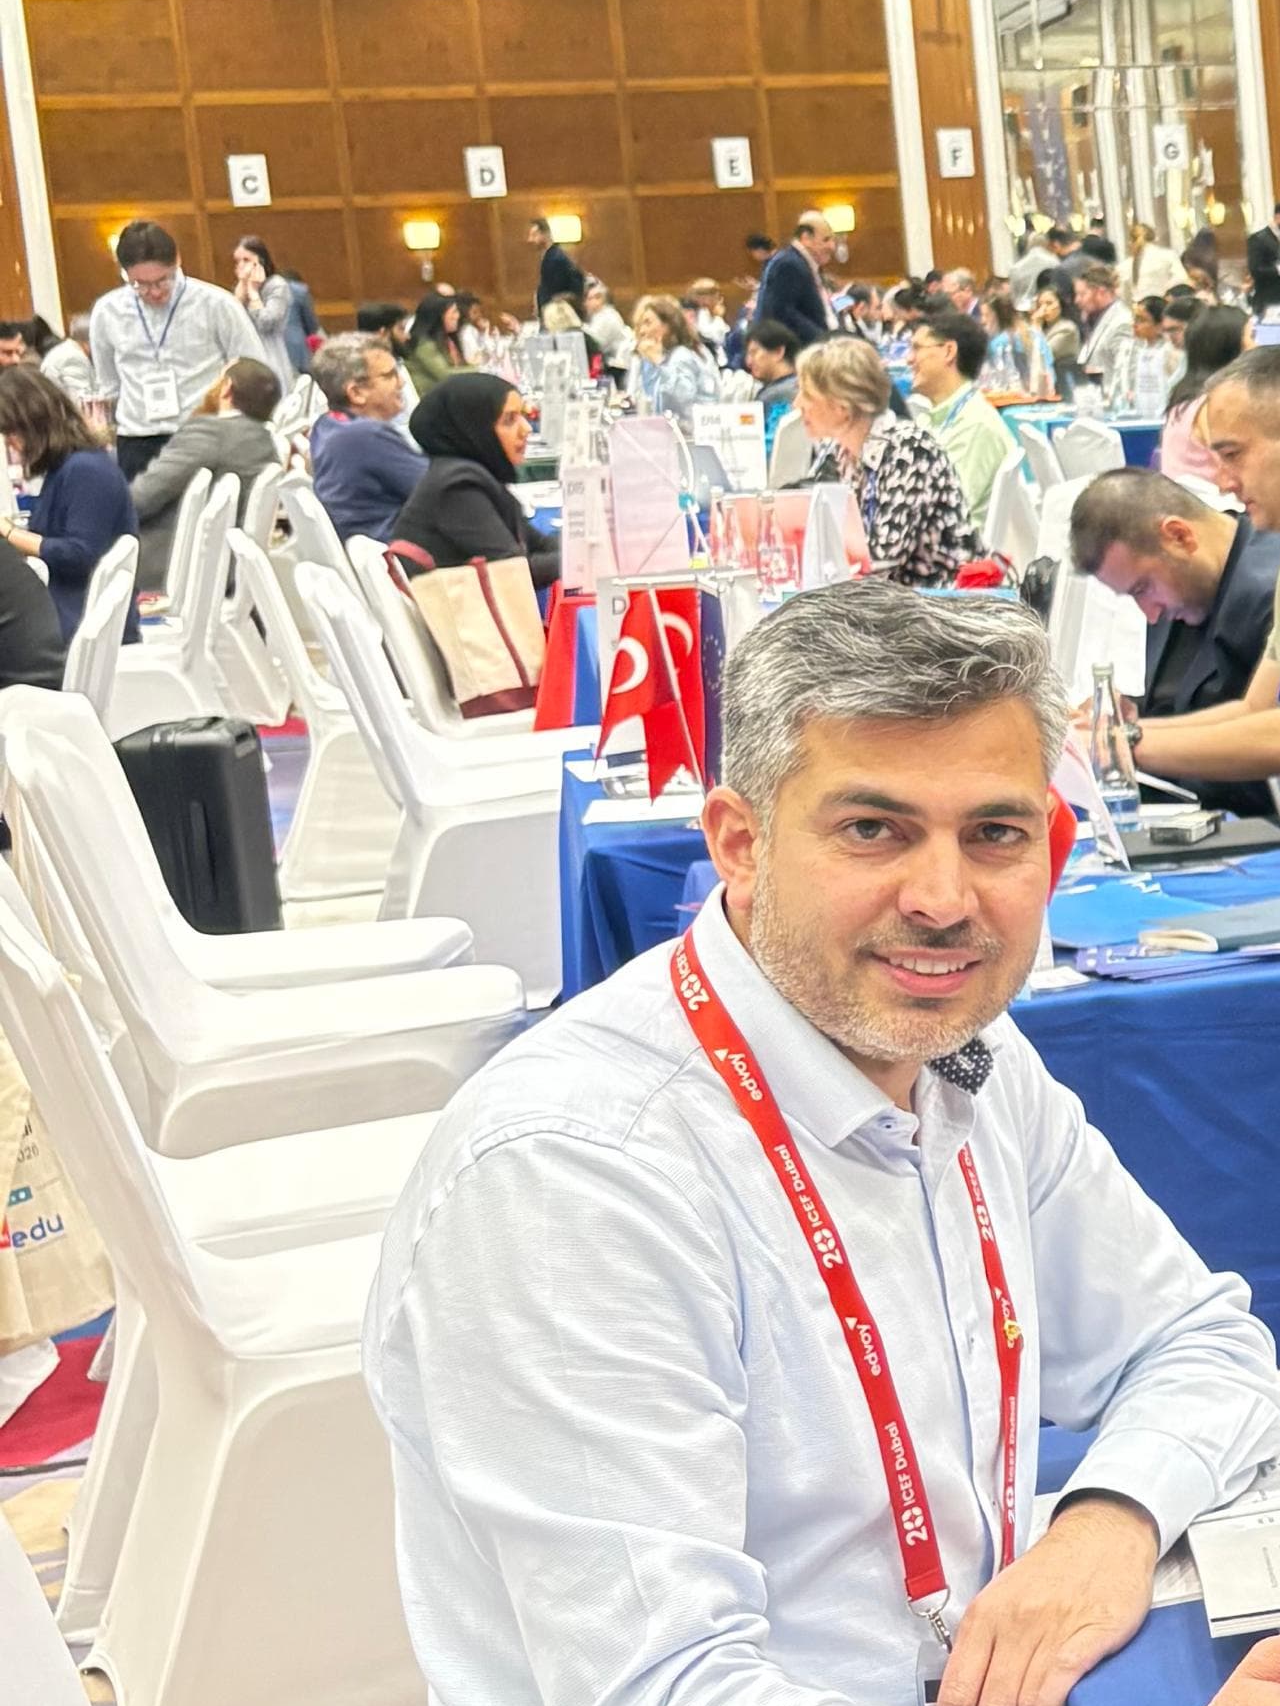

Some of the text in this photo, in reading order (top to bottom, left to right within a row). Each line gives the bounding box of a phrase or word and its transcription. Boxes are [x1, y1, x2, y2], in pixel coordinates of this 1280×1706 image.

[728, 158, 742, 178] E
[1162, 143, 1181, 160] G
[241, 175, 259, 194] C
[478, 168, 496, 187] D
[679, 972, 711, 1012] 20
[728, 1051, 764, 1103] edvoy
[773, 1143, 844, 1270] 20 ICEF Dubai
[856, 1324, 882, 1377] edvoy
[884, 1420, 929, 1547] 20 ICEF Dubai
